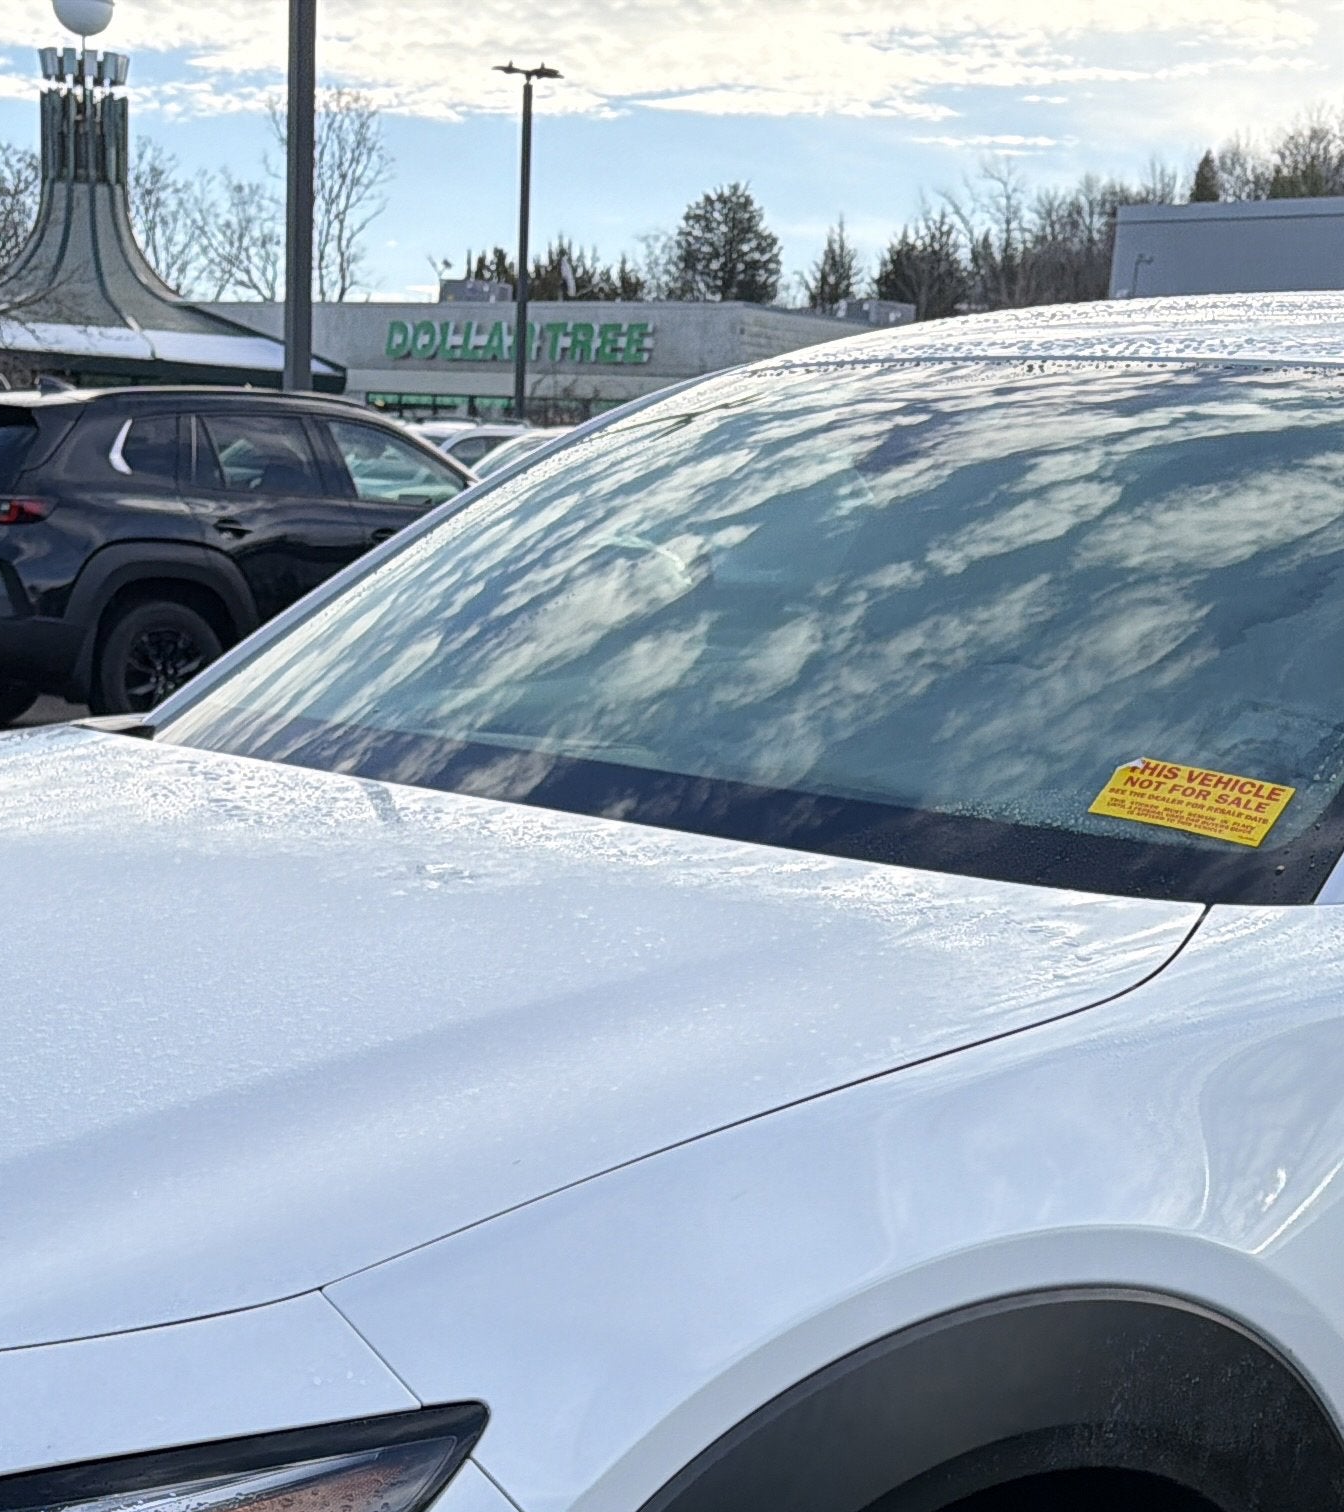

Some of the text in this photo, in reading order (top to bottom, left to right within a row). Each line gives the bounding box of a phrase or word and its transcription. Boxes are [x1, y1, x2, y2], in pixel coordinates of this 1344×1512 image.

[546, 320, 654, 364] TREE
[1123, 775, 1270, 813] NOT FOR SALE
[1186, 770, 1286, 802] VEHICLE
[1128, 790, 1146, 798] THE
[1147, 793, 1184, 805] DEALER
[1184, 801, 1206, 810] FOR
[1206, 805, 1244, 818] RESALE
